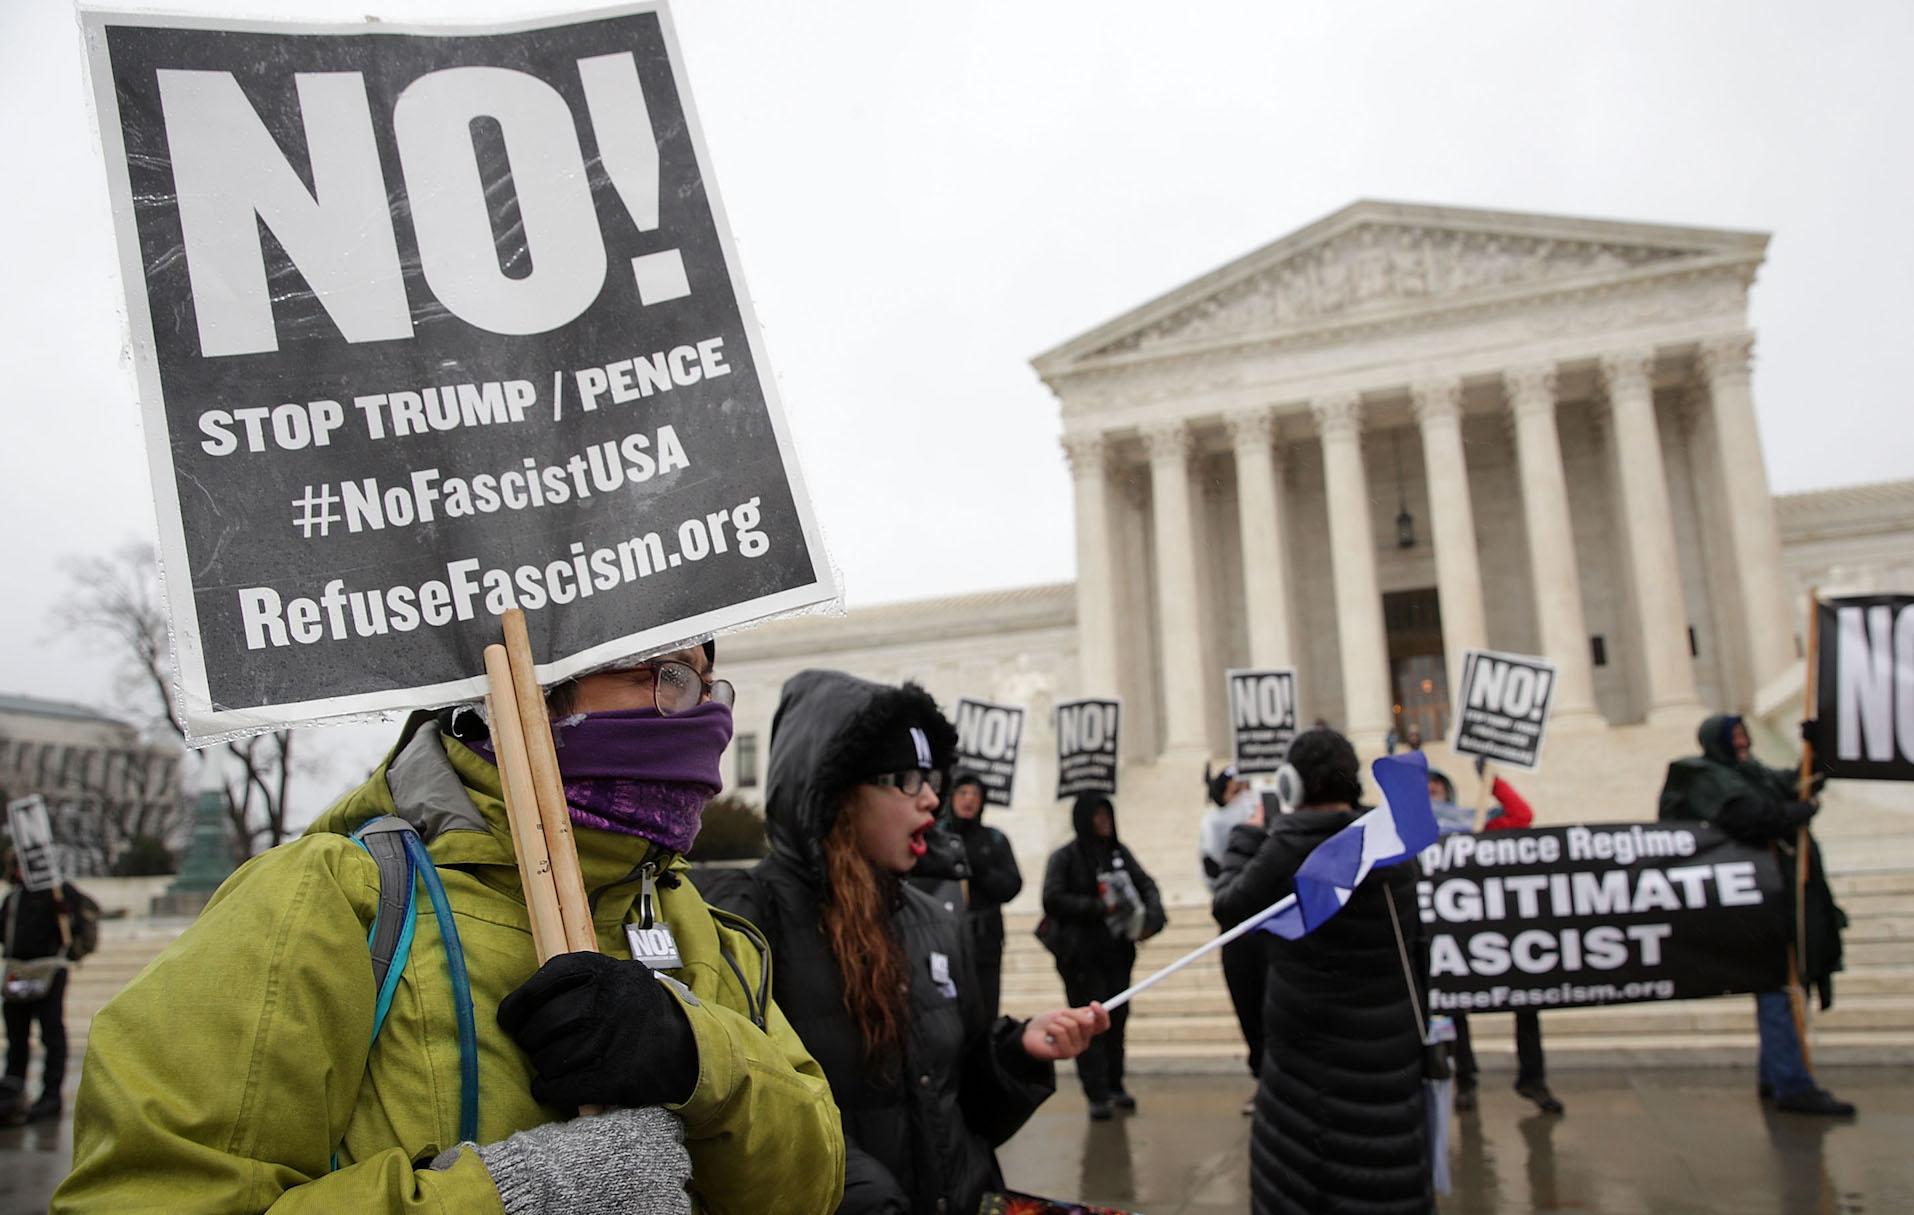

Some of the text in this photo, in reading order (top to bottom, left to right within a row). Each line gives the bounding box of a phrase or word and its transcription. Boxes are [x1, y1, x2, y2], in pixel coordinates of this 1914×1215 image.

[155, 51, 692, 358] NO!
[198, 336, 731, 457] STOP TRUMP / PENCE
[292, 424, 690, 538] #NoFascistUSA
[238, 496, 770, 650] RefuseFascism.org
[1234, 675, 1293, 728] NO!
[1469, 659, 1551, 721] NO!
[957, 702, 1020, 760] NO!
[1060, 702, 1118, 756] NO!
[1418, 825, 1697, 876] p/Pence Regime
[627, 929, 677, 956] NO!
